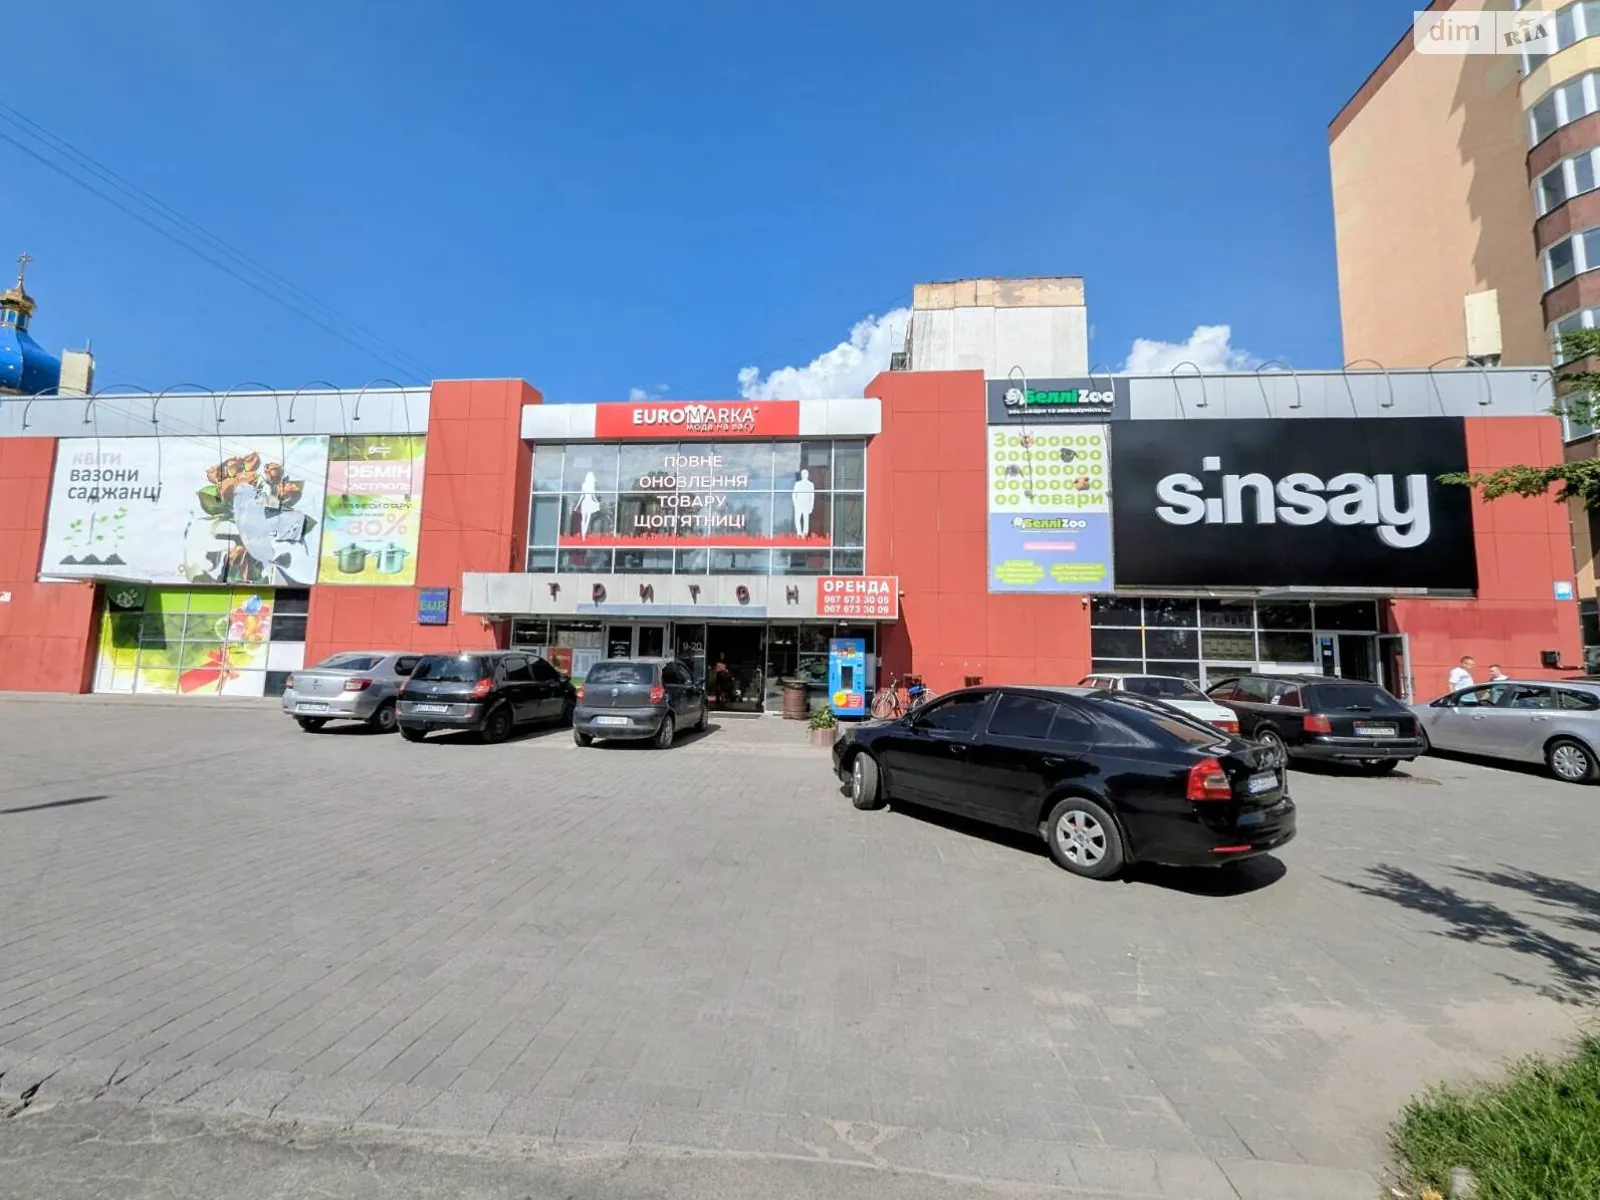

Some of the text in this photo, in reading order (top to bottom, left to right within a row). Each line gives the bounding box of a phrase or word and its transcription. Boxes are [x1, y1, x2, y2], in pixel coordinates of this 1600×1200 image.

[633, 405, 754, 423] EUROMARKA
[686, 423, 754, 433] мода на вагу
[72, 452, 121, 465] квіти
[664, 455, 723, 467] ПОВНЕ
[70, 469, 139, 482] вазони
[343, 465, 411, 479] ОБМІН
[639, 475, 748, 488] ОНОВЛЕННЯ
[68, 482, 163, 503] саджанці
[656, 495, 726, 507] ТОВАРУ
[1028, 494, 1104, 508] товари
[1156, 456, 1430, 548] sinsay
[824, 580, 890, 594] ОРЕНДА
[824, 595, 889, 604] 067 673 30 05
[824, 605, 840, 613] 067
[844, 605, 860, 613] 673
[863, 605, 874, 613] 30
